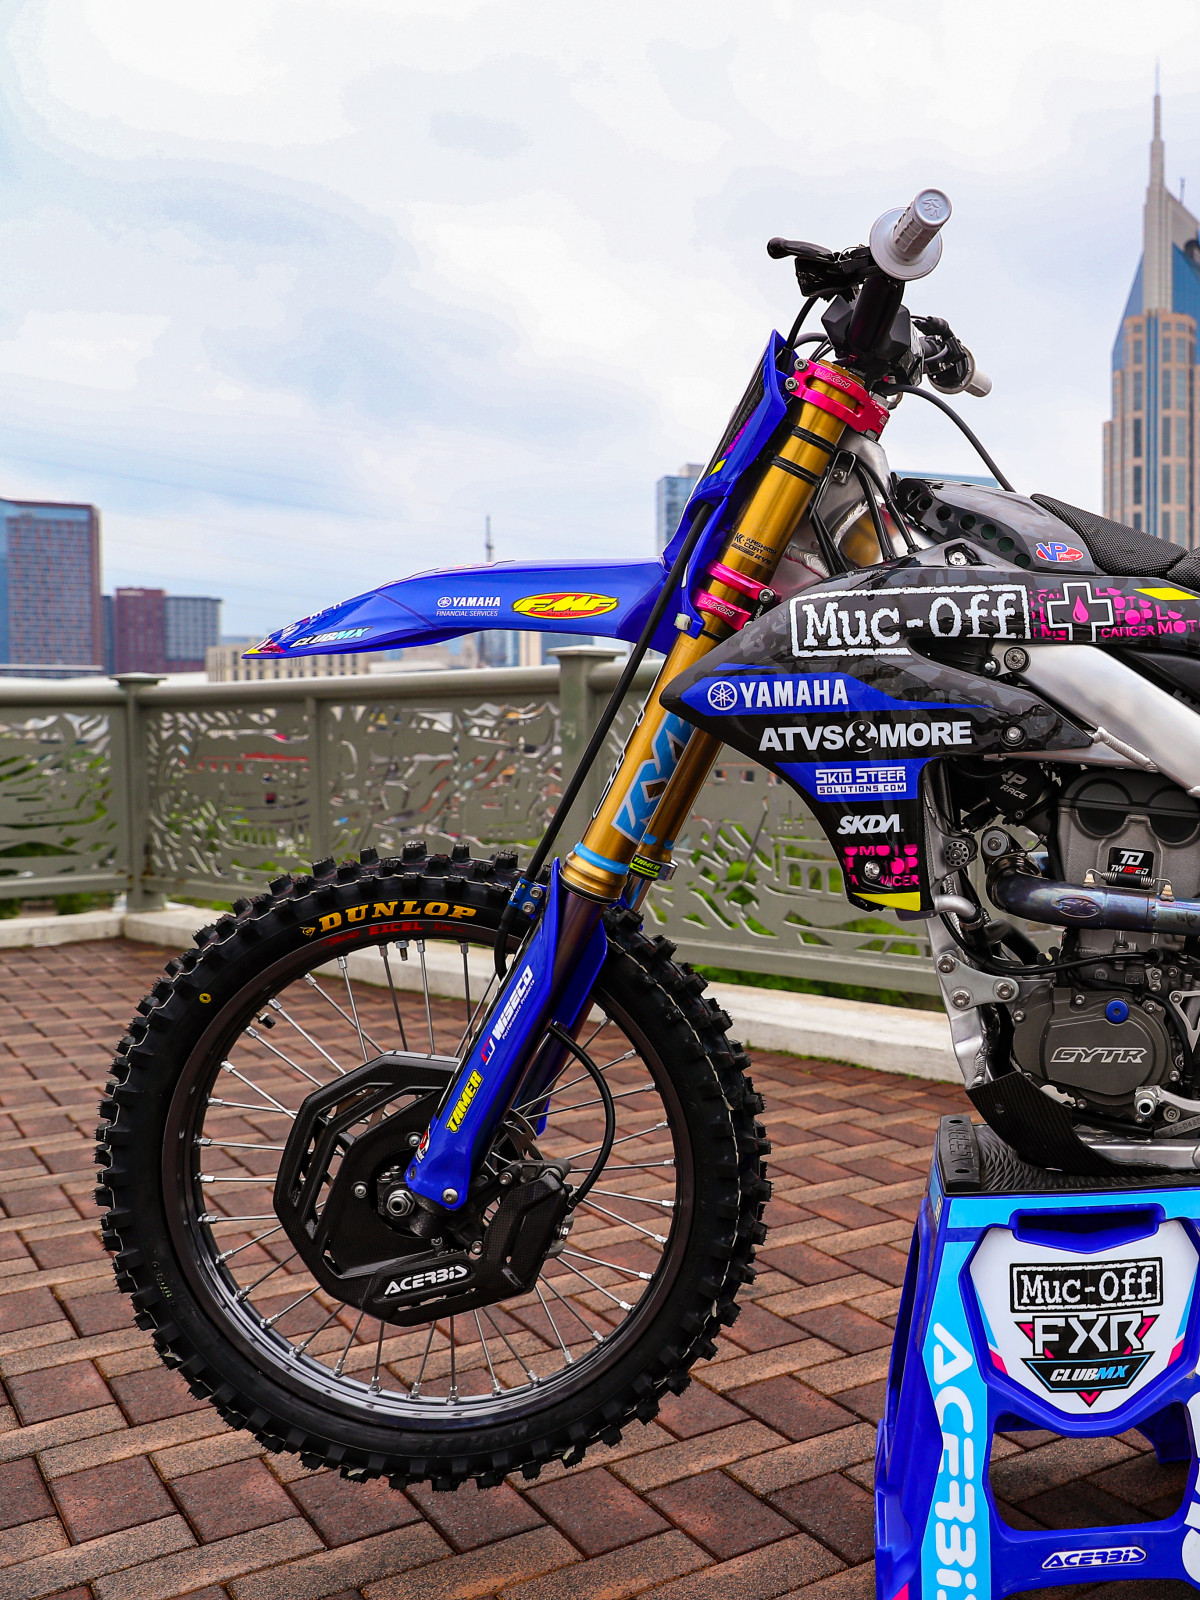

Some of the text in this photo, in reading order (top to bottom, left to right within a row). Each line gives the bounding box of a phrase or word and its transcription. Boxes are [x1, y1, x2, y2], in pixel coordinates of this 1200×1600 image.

[1036, 542, 1068, 561] VP
[452, 597, 501, 607] YAMAHA
[513, 595, 620, 613] FMF
[436, 609, 498, 617] FINANCIAL SERVICES
[802, 593, 1018, 647] Muc-Off
[289, 626, 371, 648] CLUBMX
[1101, 625, 1156, 638] CANCER
[740, 678, 849, 708] YAMAHA
[759, 720, 972, 754] ATVS&MORE
[815, 766, 906, 784] SKID STEER
[819, 784, 905, 794] SOLUTIONS.COM
[1000, 784, 1028, 799] RACE
[837, 814, 900, 834] SKDA
[318, 900, 477, 932] DUNLOP
[368, 922, 423, 935] EXCEL
[1051, 1047, 1147, 1064] GYTR
[446, 1069, 483, 1133] TAMER
[384, 1265, 468, 1296] ACERBIS
[1021, 1265, 1156, 1304] Muc-Off
[1032, 1315, 1146, 1356] FXR
[1050, 1365, 1130, 1382] CLUBMX
[932, 1322, 977, 1600] ACERBI
[1043, 1548, 1147, 1569] ACERBIS
